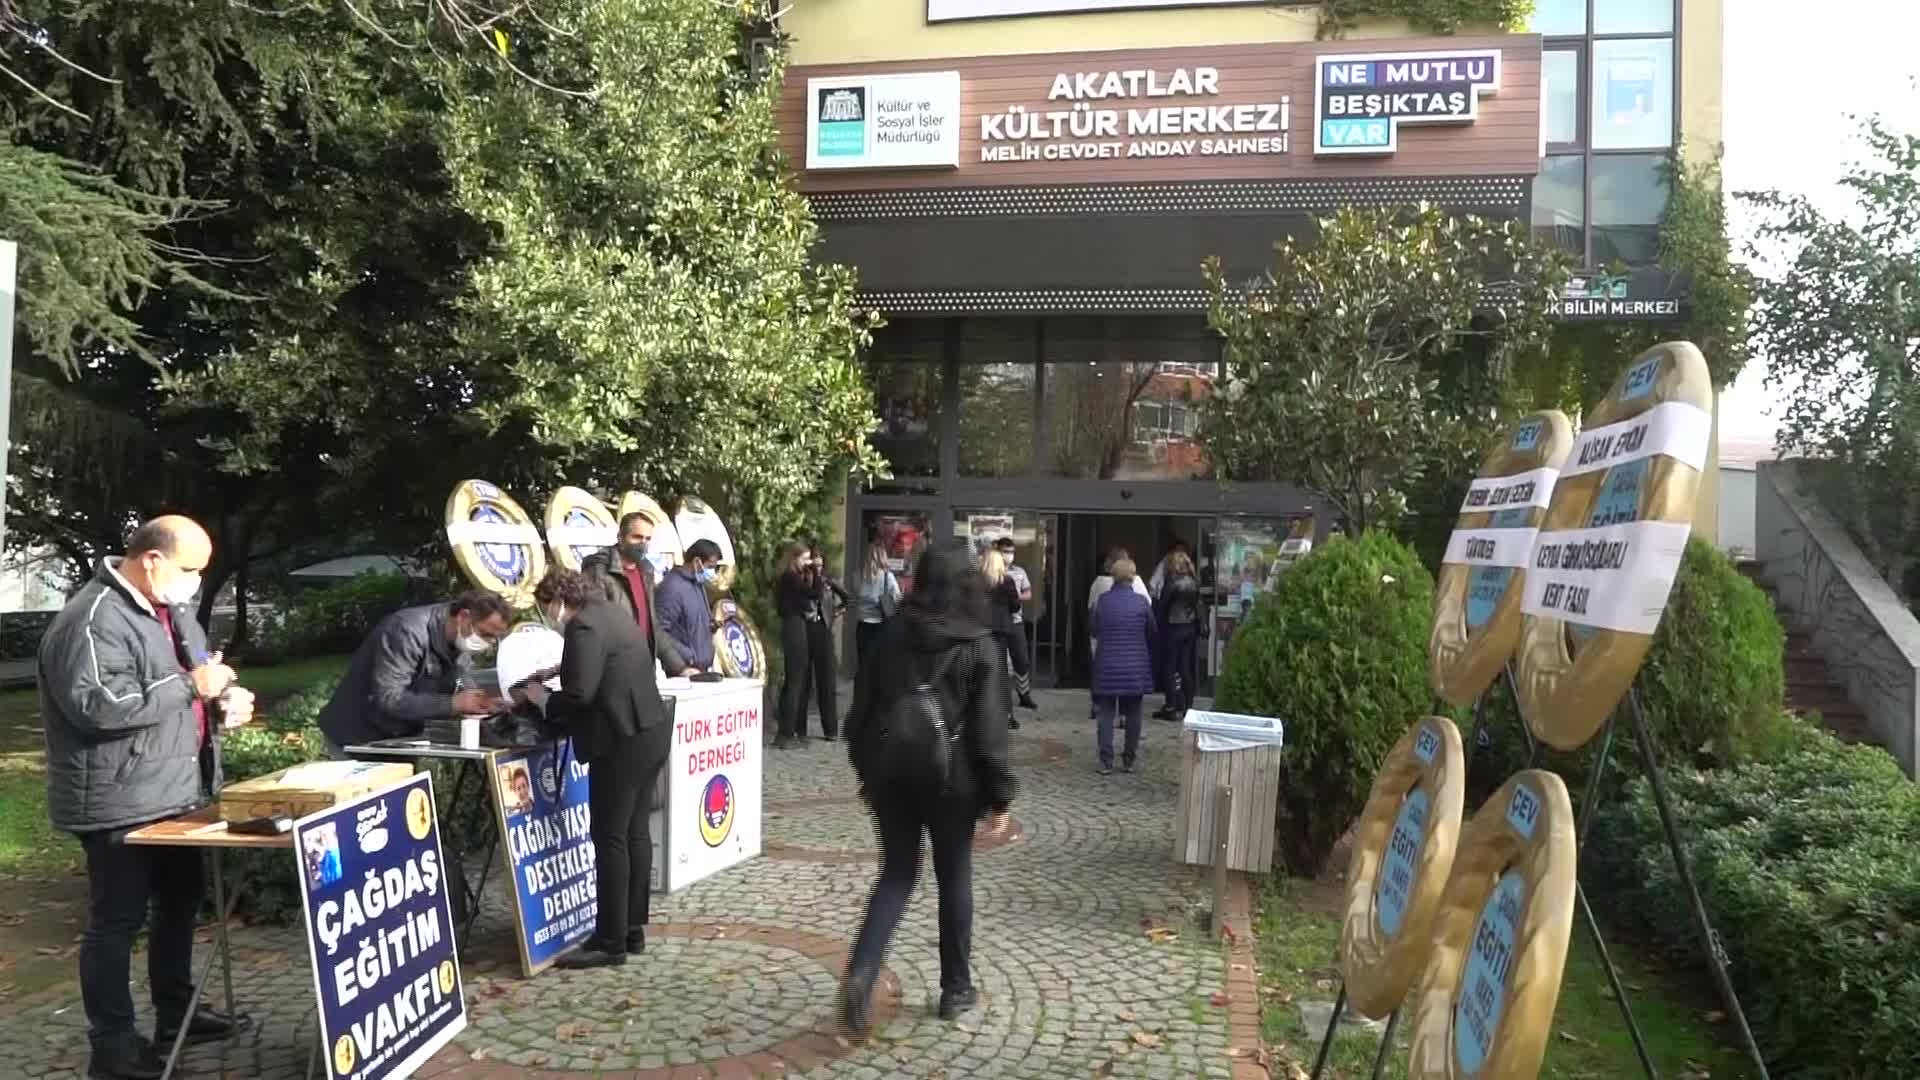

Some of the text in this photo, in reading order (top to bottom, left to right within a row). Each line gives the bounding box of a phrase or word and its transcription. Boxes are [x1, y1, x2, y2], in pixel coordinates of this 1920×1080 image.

[1048, 66, 1219, 100] AKATLAR
[1329, 61, 1486, 84] NE MUTLU
[877, 99, 931, 113] Kültür ve
[877, 112, 945, 129] Sosyal İşler
[981, 95, 1291, 141] KÜLTÜR MERKEZİ
[876, 129, 941, 145] Müdürlüğü
[981, 132, 1289, 162] MELİH CEVDET ANDAY SAHNESİ
[1328, 123, 1385, 146] VAR
[1564, 299, 1606, 315] BİLİM
[1611, 298, 1680, 315] MERKEZİ
[508, 813, 562, 866] ÇAĞDAŞ
[316, 850, 440, 956] ÇAĞDAŞ
[543, 870, 598, 922] DERNEĞ
[333, 906, 442, 1007] EĞİTİM
[349, 966, 442, 1061] VAKFI
